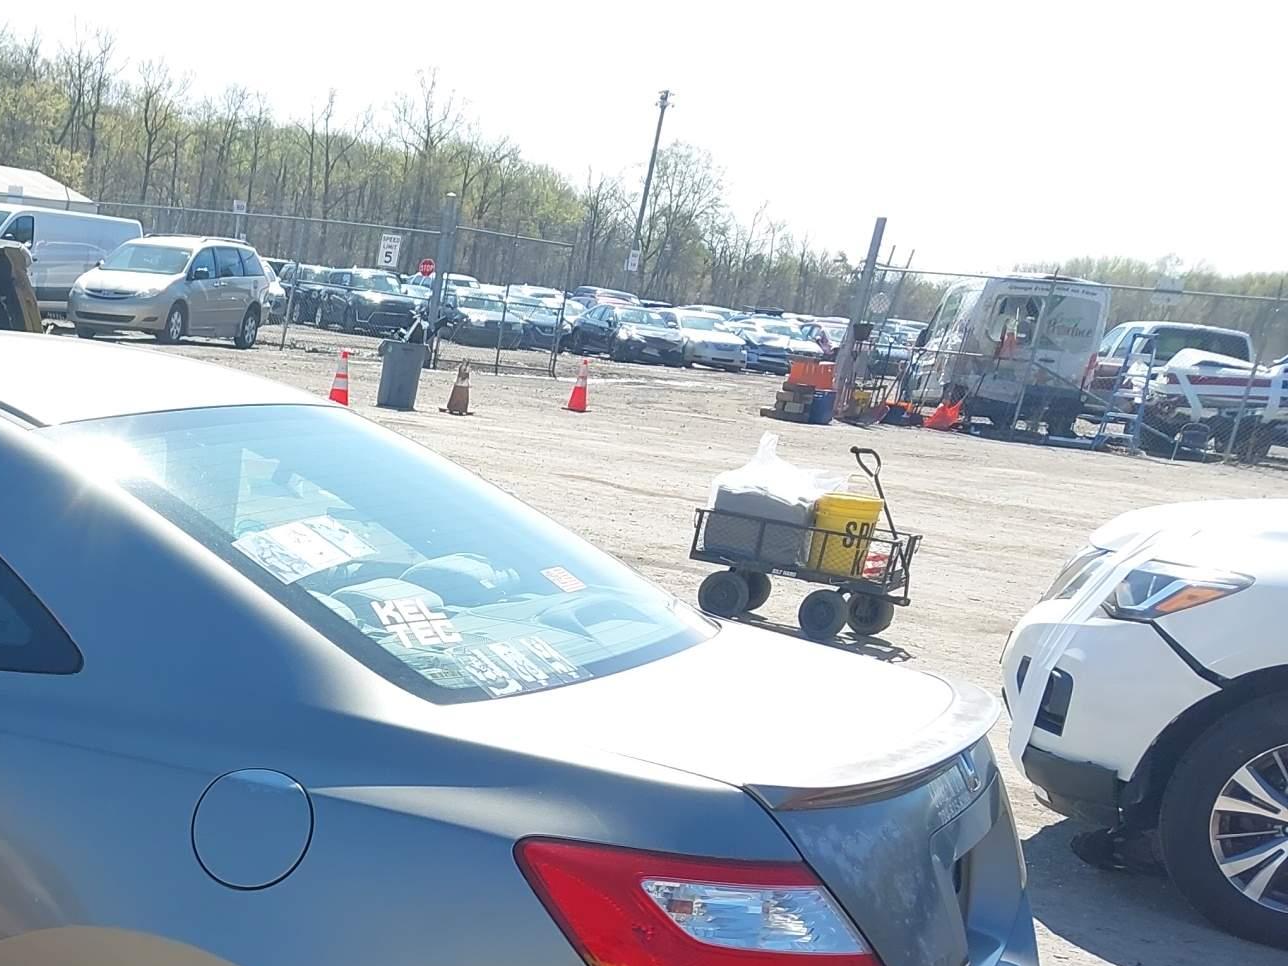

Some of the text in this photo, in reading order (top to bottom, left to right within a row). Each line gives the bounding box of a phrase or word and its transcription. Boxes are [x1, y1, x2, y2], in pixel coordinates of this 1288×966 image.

[384, 251, 393, 264] 5
[370, 599, 448, 625] KEL
[386, 619, 463, 648] TEC
